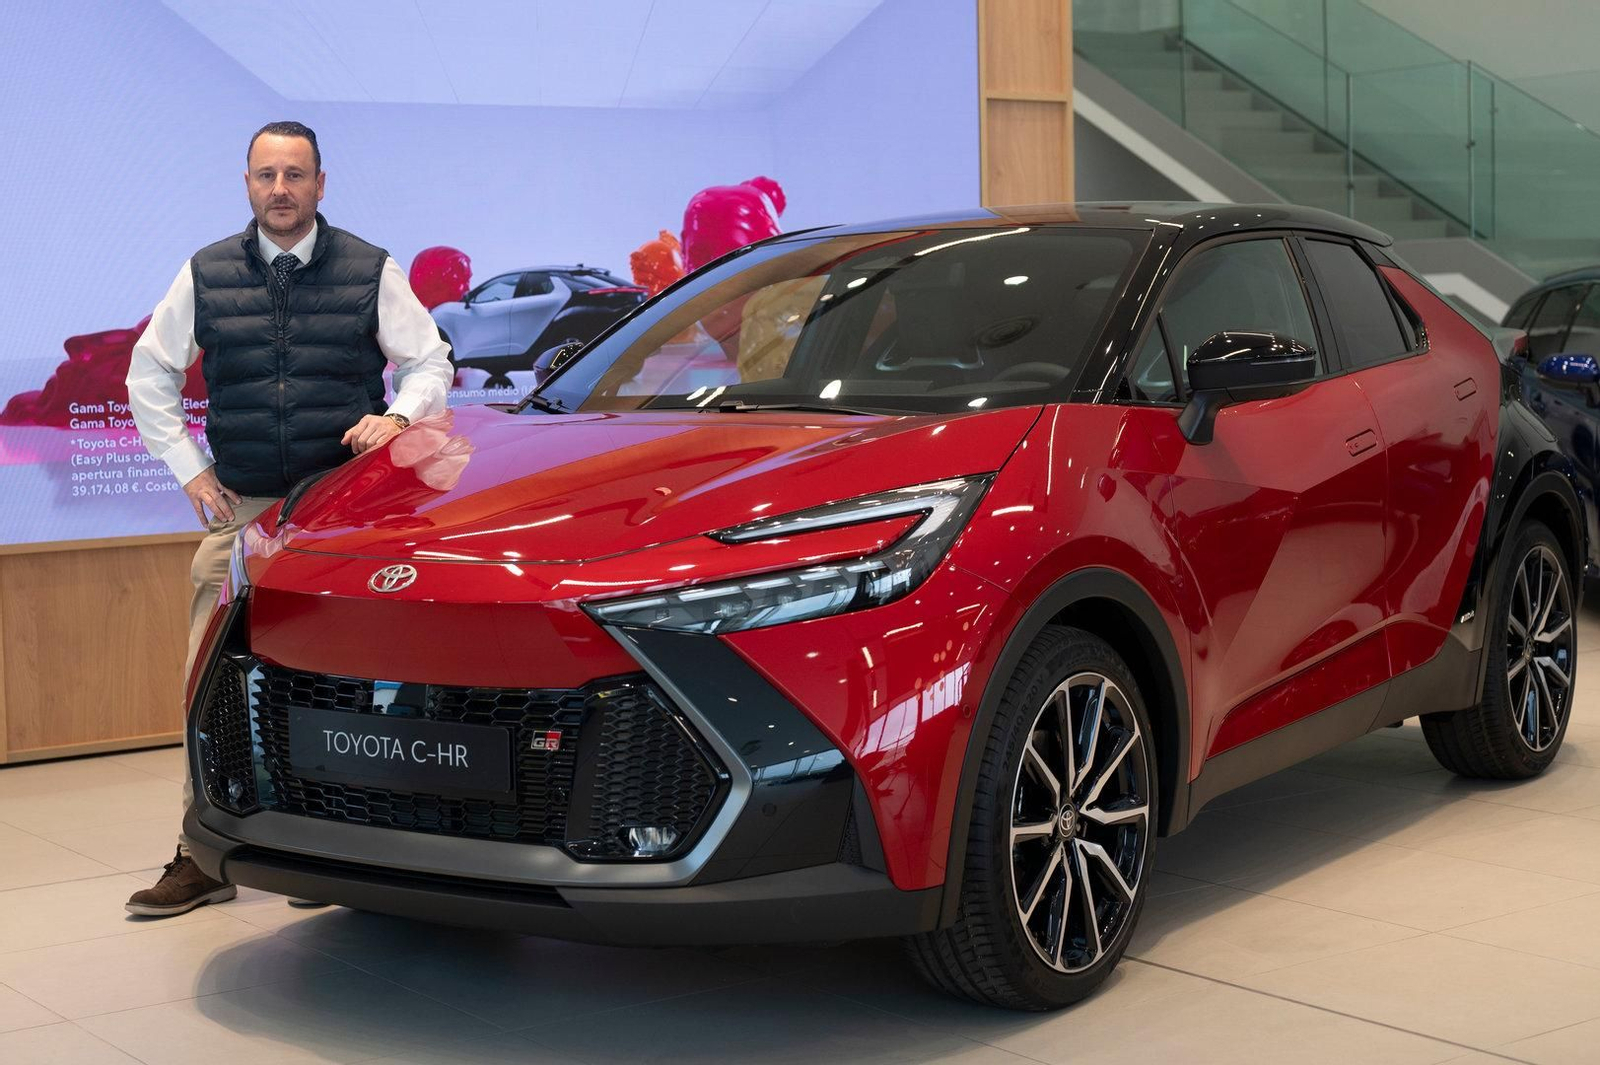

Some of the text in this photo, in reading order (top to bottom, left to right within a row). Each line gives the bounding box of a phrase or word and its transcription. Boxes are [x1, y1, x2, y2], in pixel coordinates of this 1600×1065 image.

[69, 402, 105, 414] Gama
[107, 401, 131, 414] Toyo
[183, 398, 210, 410] Elect
[447, 387, 486, 399] onsumo
[70, 418, 105, 430] Gama
[108, 416, 135, 430] Toyo
[119, 436, 144, 447] C-H
[71, 453, 103, 467] (Easy
[106, 452, 131, 464] Plus
[72, 465, 174, 483] apertura financia
[72, 482, 129, 497] 39.174,08
[145, 481, 179, 492] Coste
[323, 730, 469, 768] TOYOTA C-HR
[532, 736, 560, 749] GR
